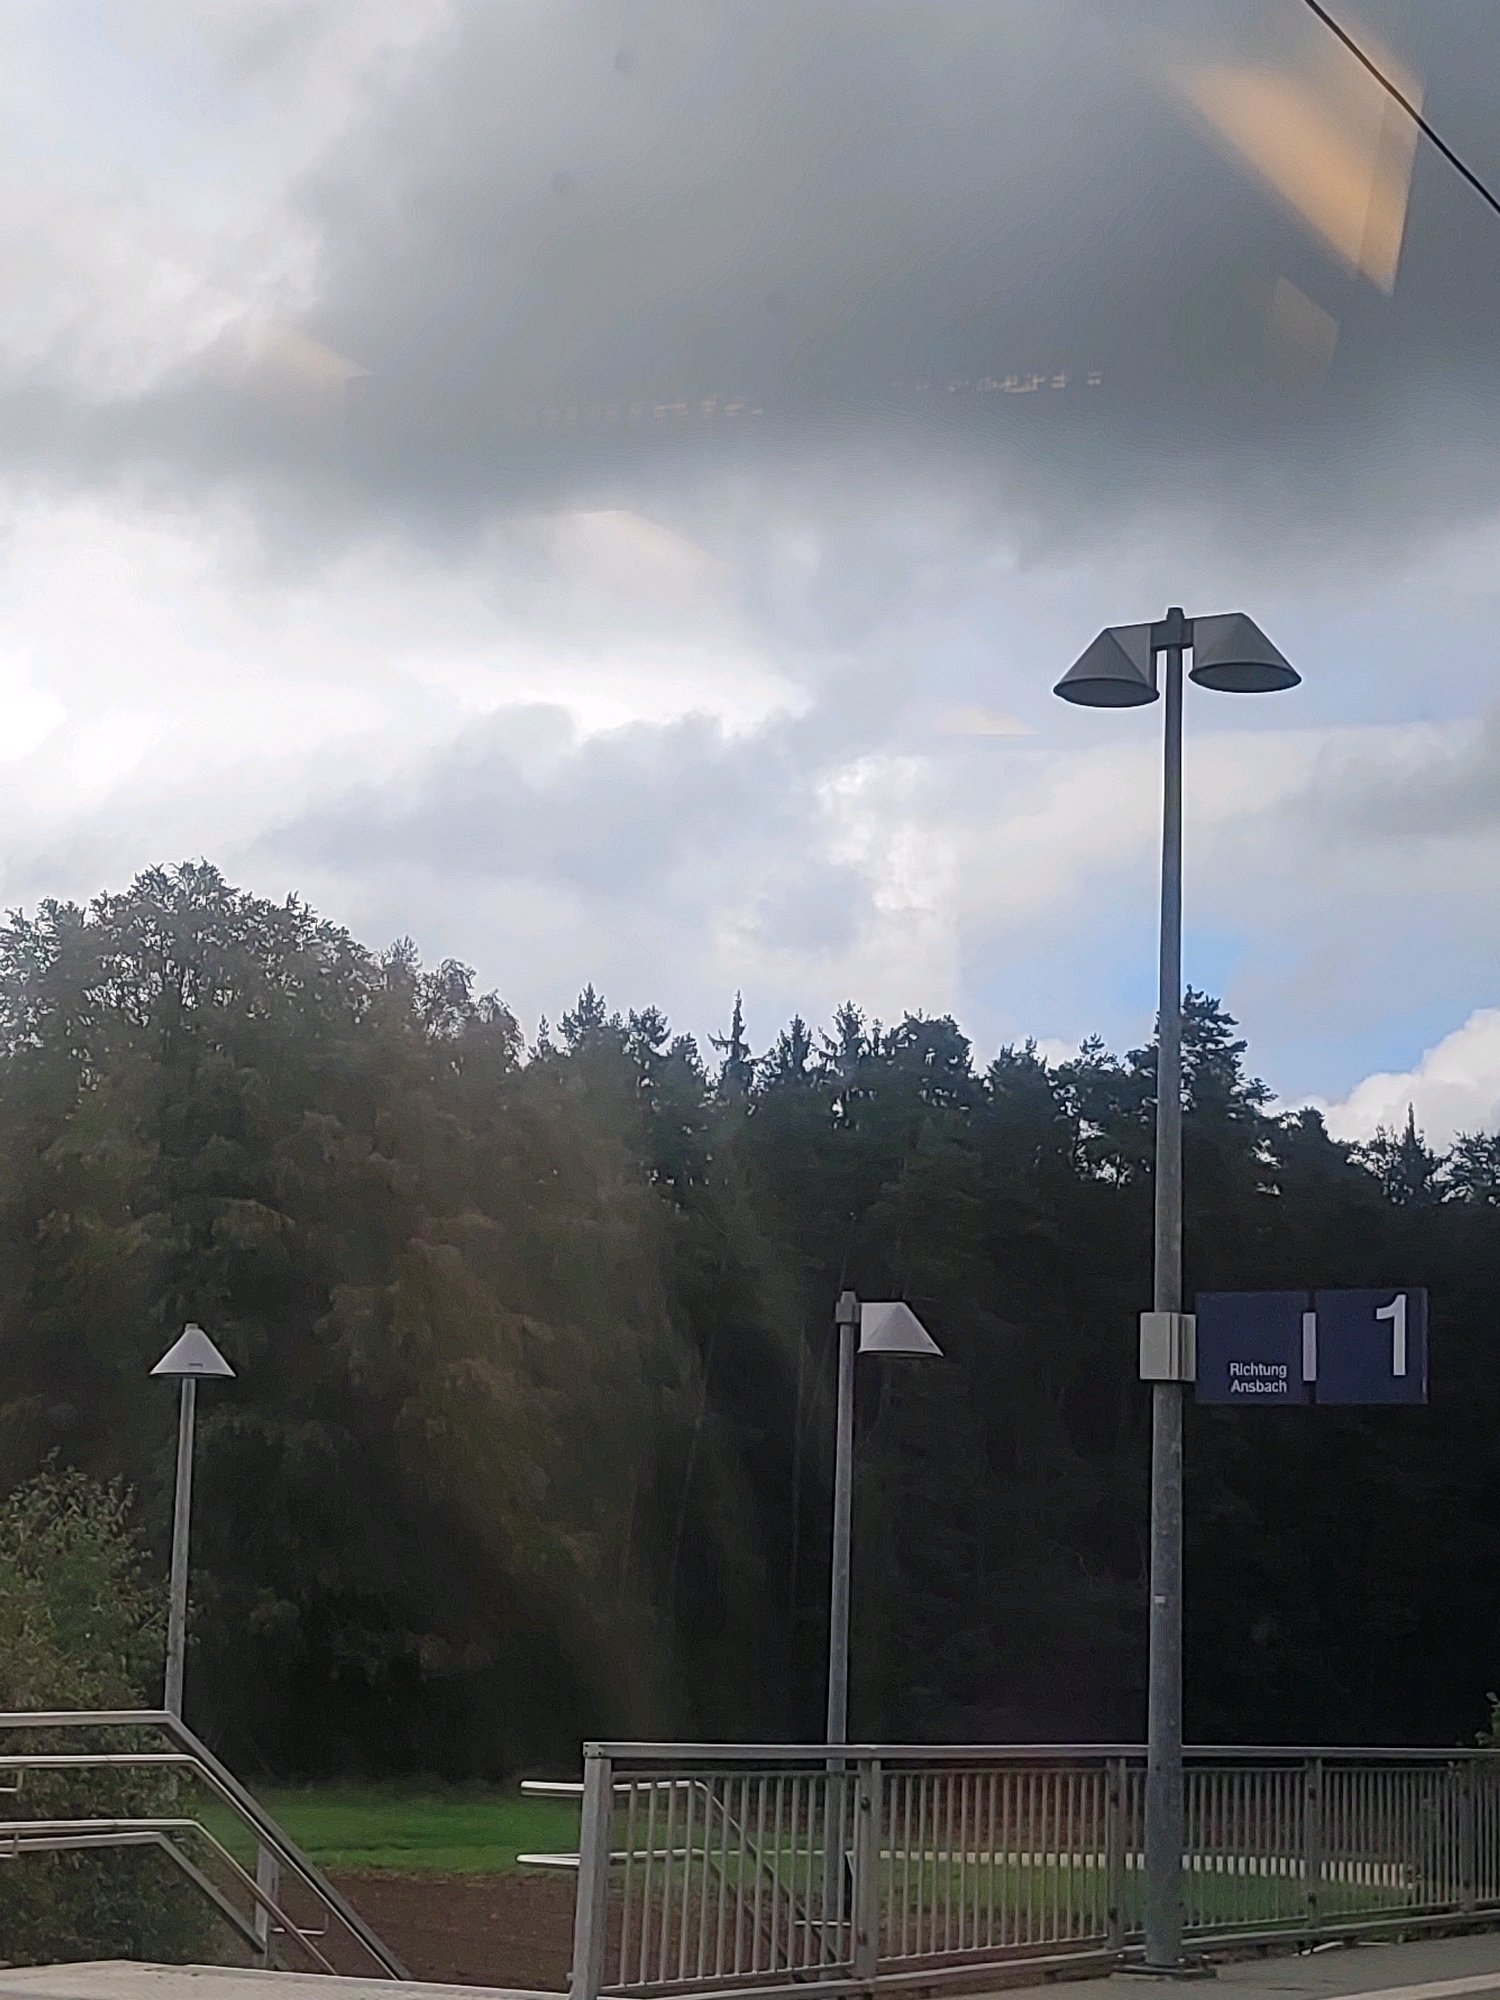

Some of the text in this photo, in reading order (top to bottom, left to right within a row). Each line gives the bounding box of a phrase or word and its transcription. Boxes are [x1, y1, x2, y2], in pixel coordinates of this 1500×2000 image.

[1375, 1294, 1406, 1376] 1
[1229, 1362, 1287, 1378] Richtung
[1230, 1379, 1287, 1393] Ansbach
